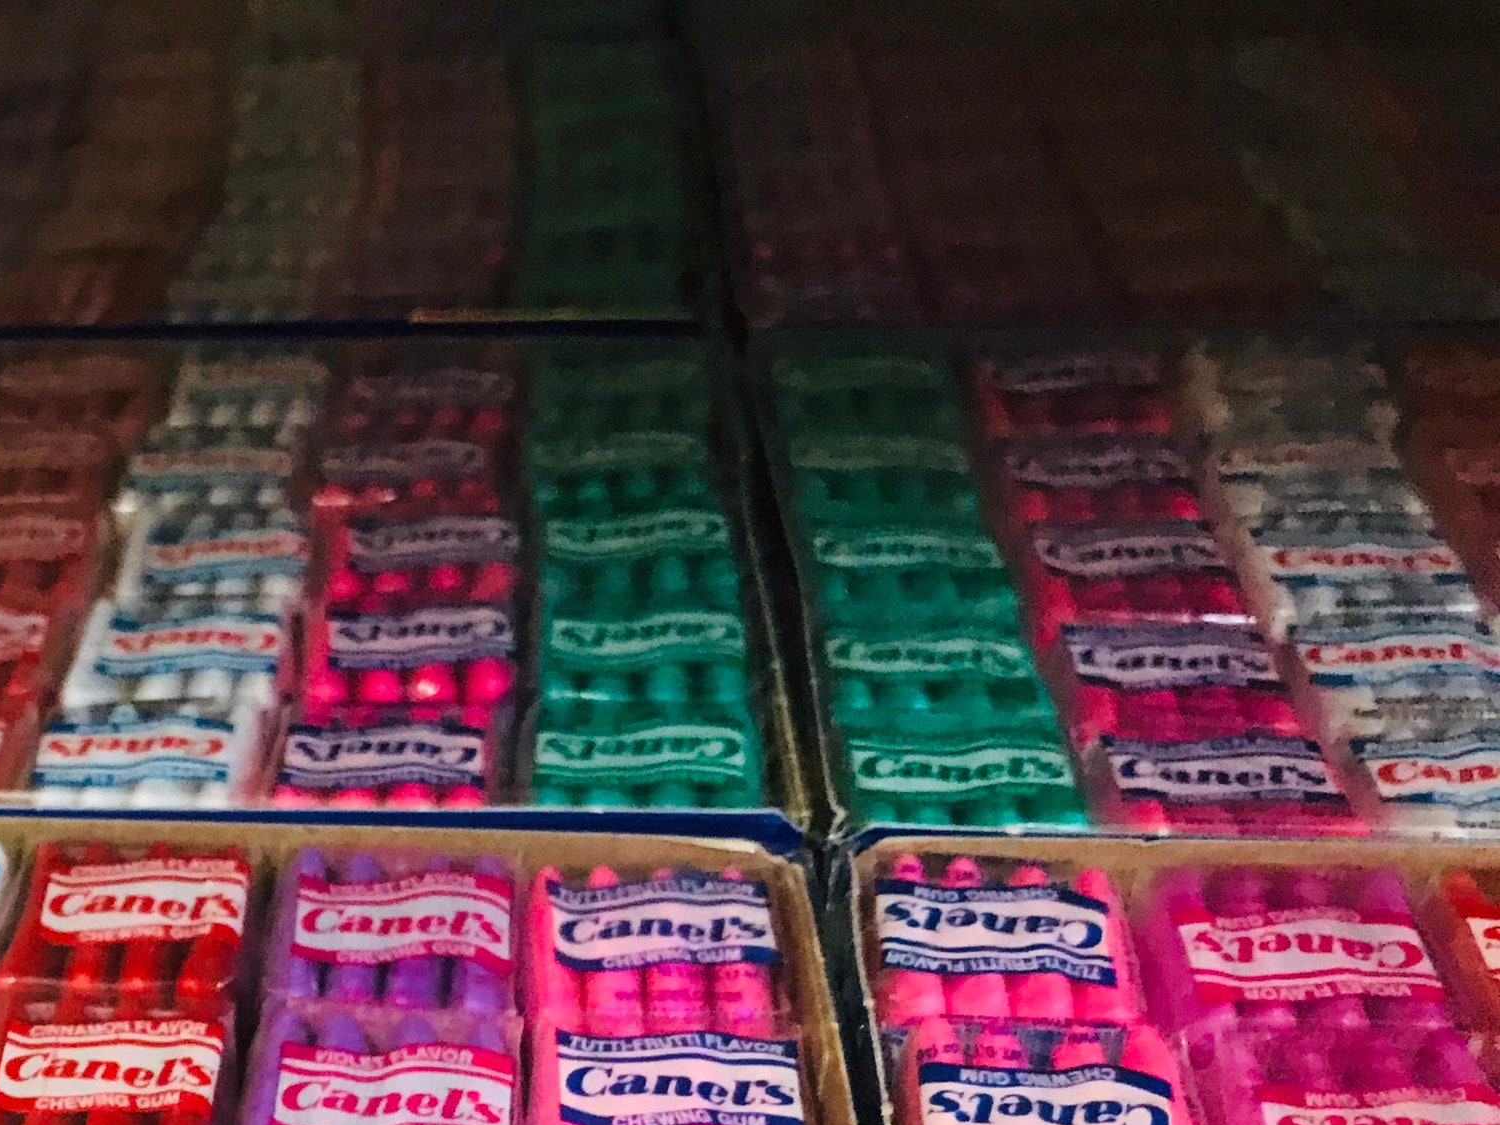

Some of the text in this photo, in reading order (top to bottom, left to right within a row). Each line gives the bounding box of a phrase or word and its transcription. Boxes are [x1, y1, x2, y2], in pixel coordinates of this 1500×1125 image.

[50, 891, 239, 920] Canel's
[299, 902, 508, 946] Canel's
[558, 910, 770, 948] Canel's
[887, 903, 1105, 949] Canel's
[1195, 930, 1423, 968] Canel's
[566, 1034, 786, 1058] TUTTI-FRUTTI FLAVOR
[5, 1052, 212, 1088] Canel's
[564, 1065, 796, 1108] Canel's
[959, 1065, 1116, 1088] CHEWING GUM
[36, 1092, 180, 1110] CHEWING GUM
